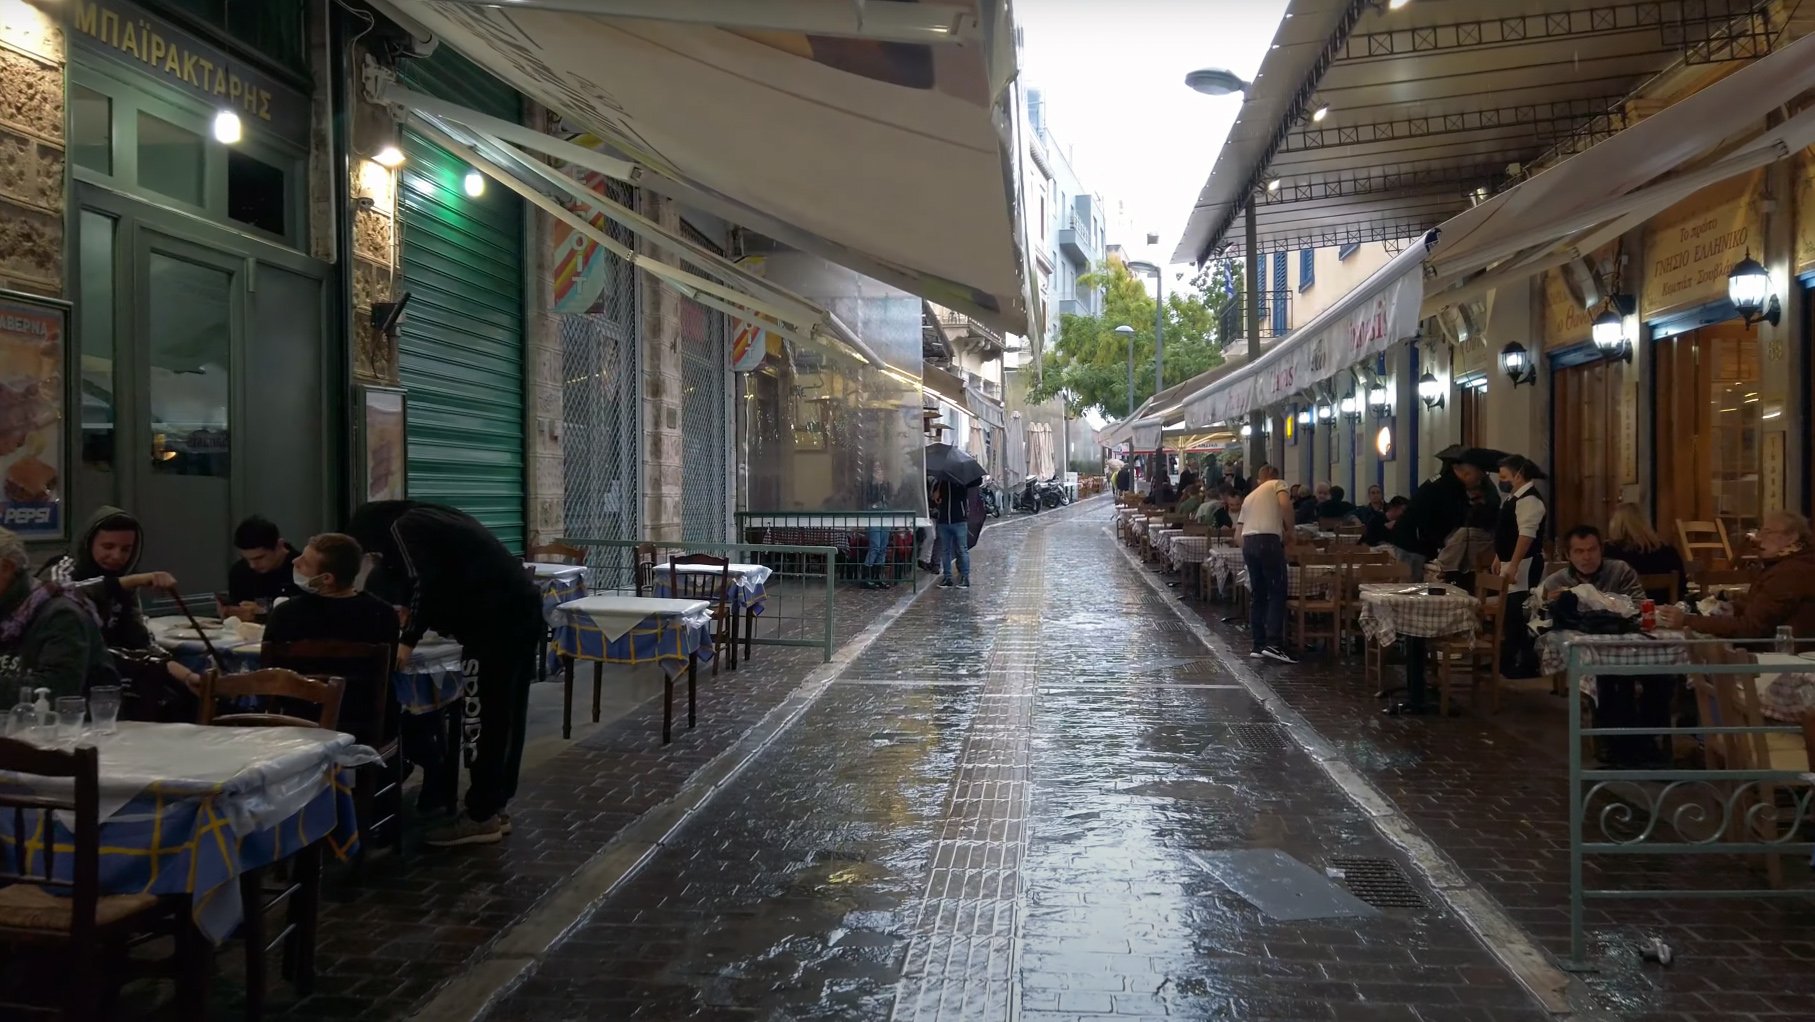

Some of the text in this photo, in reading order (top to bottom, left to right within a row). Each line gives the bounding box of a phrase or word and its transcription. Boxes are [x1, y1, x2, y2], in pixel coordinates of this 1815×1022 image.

[75, 0, 272, 121] ΜΠΑΪΡΑΚΤΑΡΗΣ
[1655, 227, 1748, 277] ΓΝΗΣΙΟ ΕΛΛΗΝΙΚΟ
[4, 507, 50, 524] PEPSI
